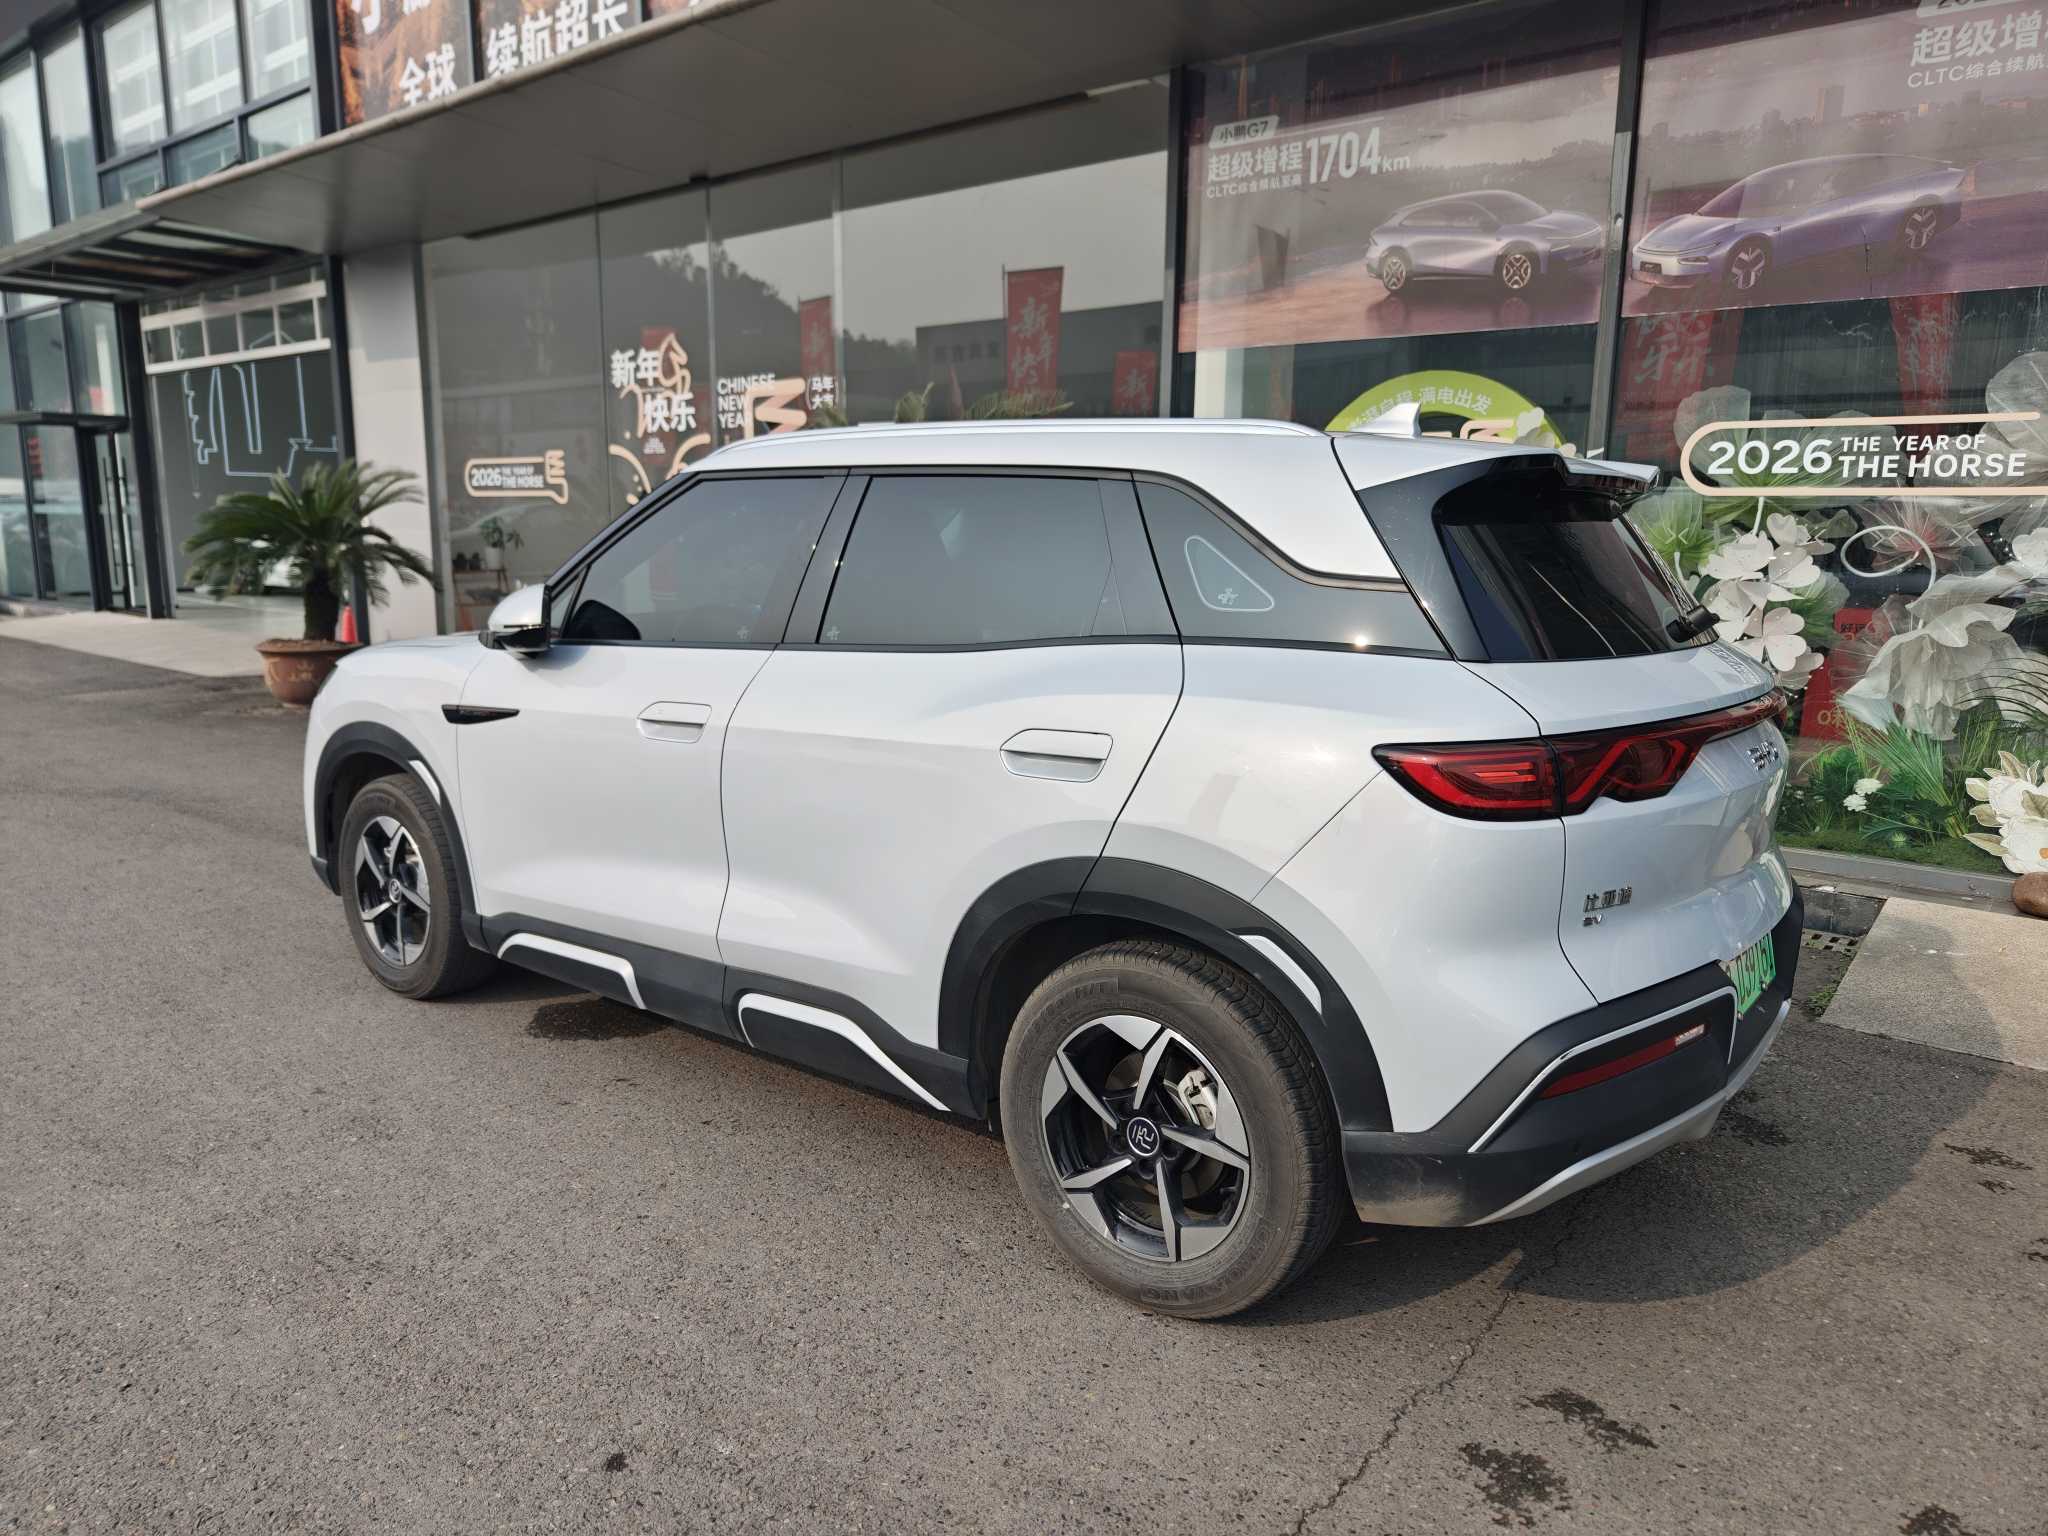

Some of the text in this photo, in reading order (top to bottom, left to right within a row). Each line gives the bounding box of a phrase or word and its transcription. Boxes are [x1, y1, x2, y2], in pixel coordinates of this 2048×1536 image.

[486, 0, 628, 77] 续航超长
[1910, 10, 2048, 67] 超级增
[399, 43, 459, 106] 全球
[1907, 53, 2048, 88] CLTC综合续航
[1208, 142, 1303, 182] 超级增程
[611, 347, 661, 388] 新年
[644, 391, 697, 433] 快乐
[718, 411, 752, 429] YEA
[1420, 387, 1491, 416] 满电出发
[1708, 433, 1987, 475] 2026 THE YEAR OF
[1838, 453, 2027, 478] THE HORSE
[471, 467, 502, 487] 2026
